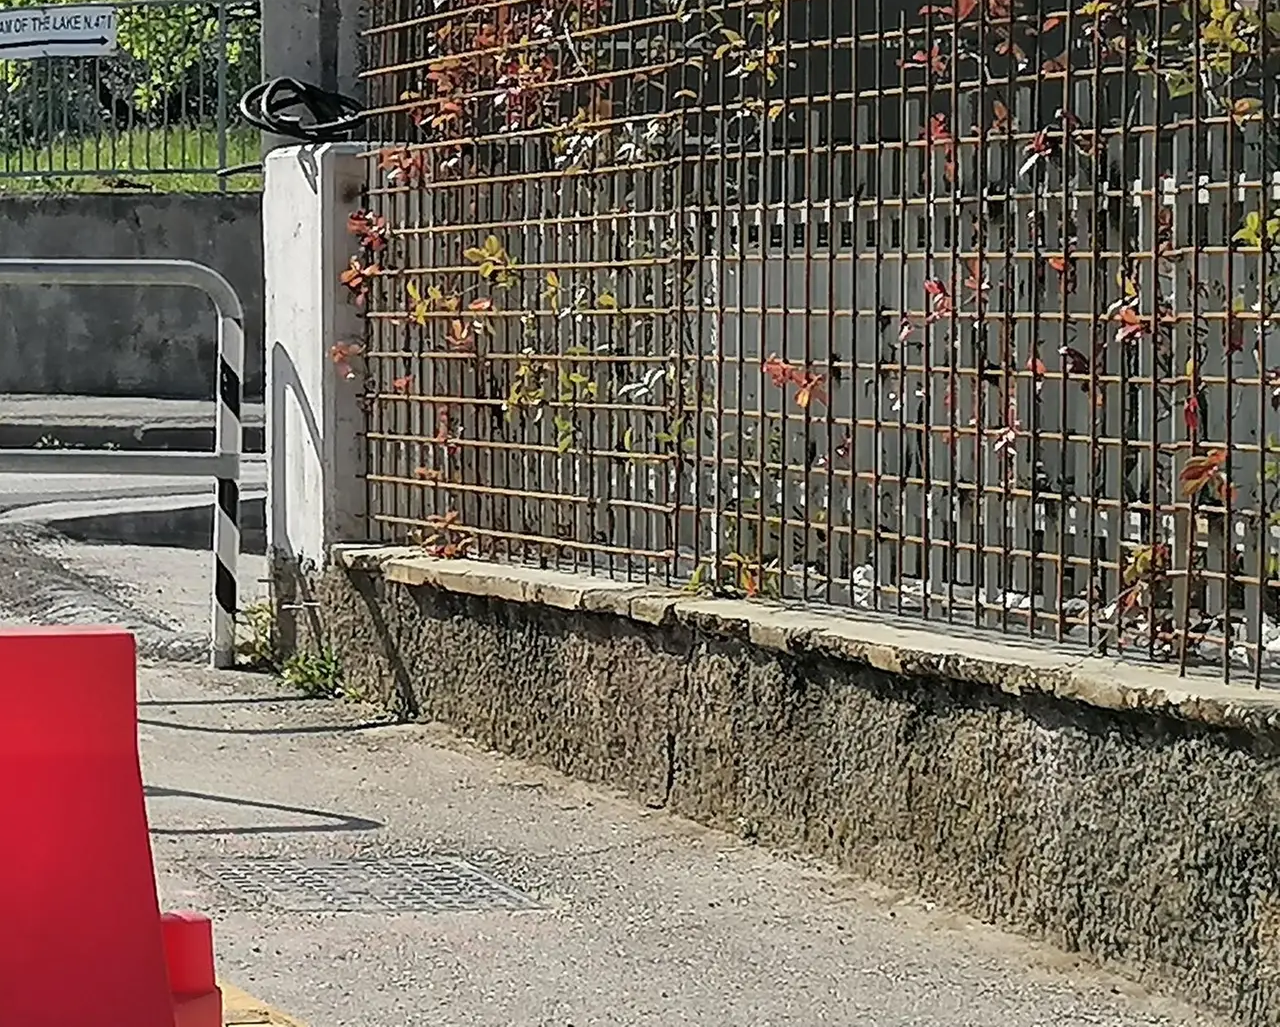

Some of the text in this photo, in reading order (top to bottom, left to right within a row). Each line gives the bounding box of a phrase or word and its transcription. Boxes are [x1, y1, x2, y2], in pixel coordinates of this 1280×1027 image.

[14, 17, 29, 33] OF
[30, 15, 51, 31] THE
[52, 15, 82, 30] LAKE
